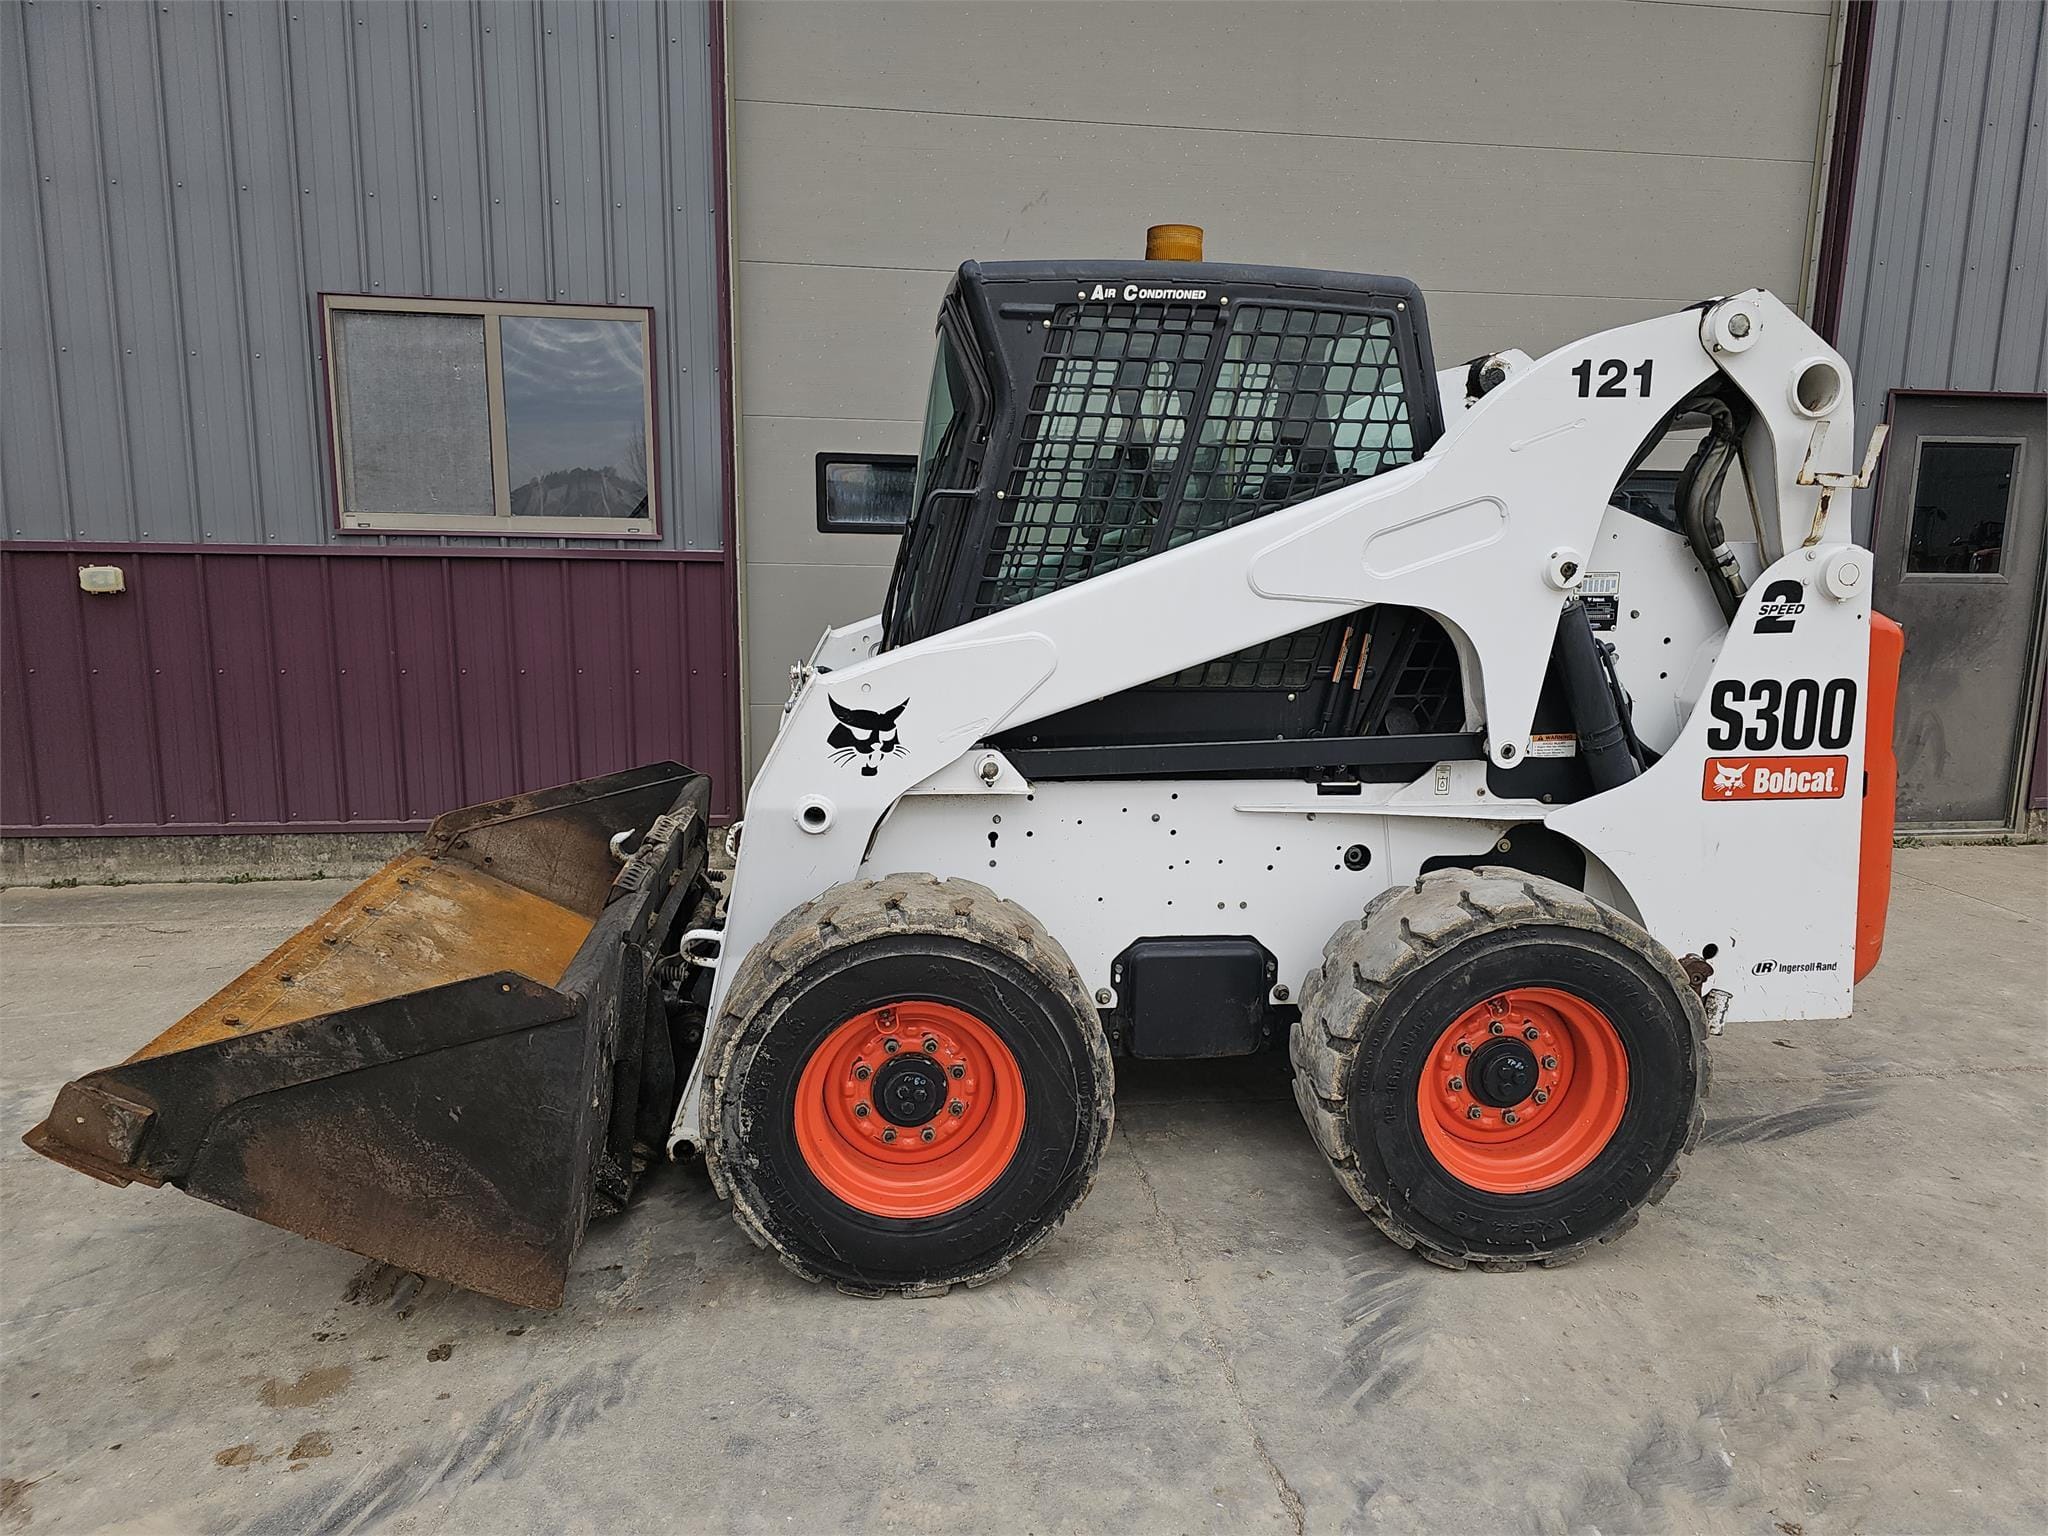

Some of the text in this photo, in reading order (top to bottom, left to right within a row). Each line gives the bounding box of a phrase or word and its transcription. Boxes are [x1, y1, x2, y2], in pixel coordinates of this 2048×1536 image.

[1571, 359, 1653, 398] 121
[1754, 580, 1803, 634] 2
[1759, 604, 1805, 615] SPEED
[1707, 678, 1857, 751] S300
[1753, 768, 1834, 793] Bobcat
